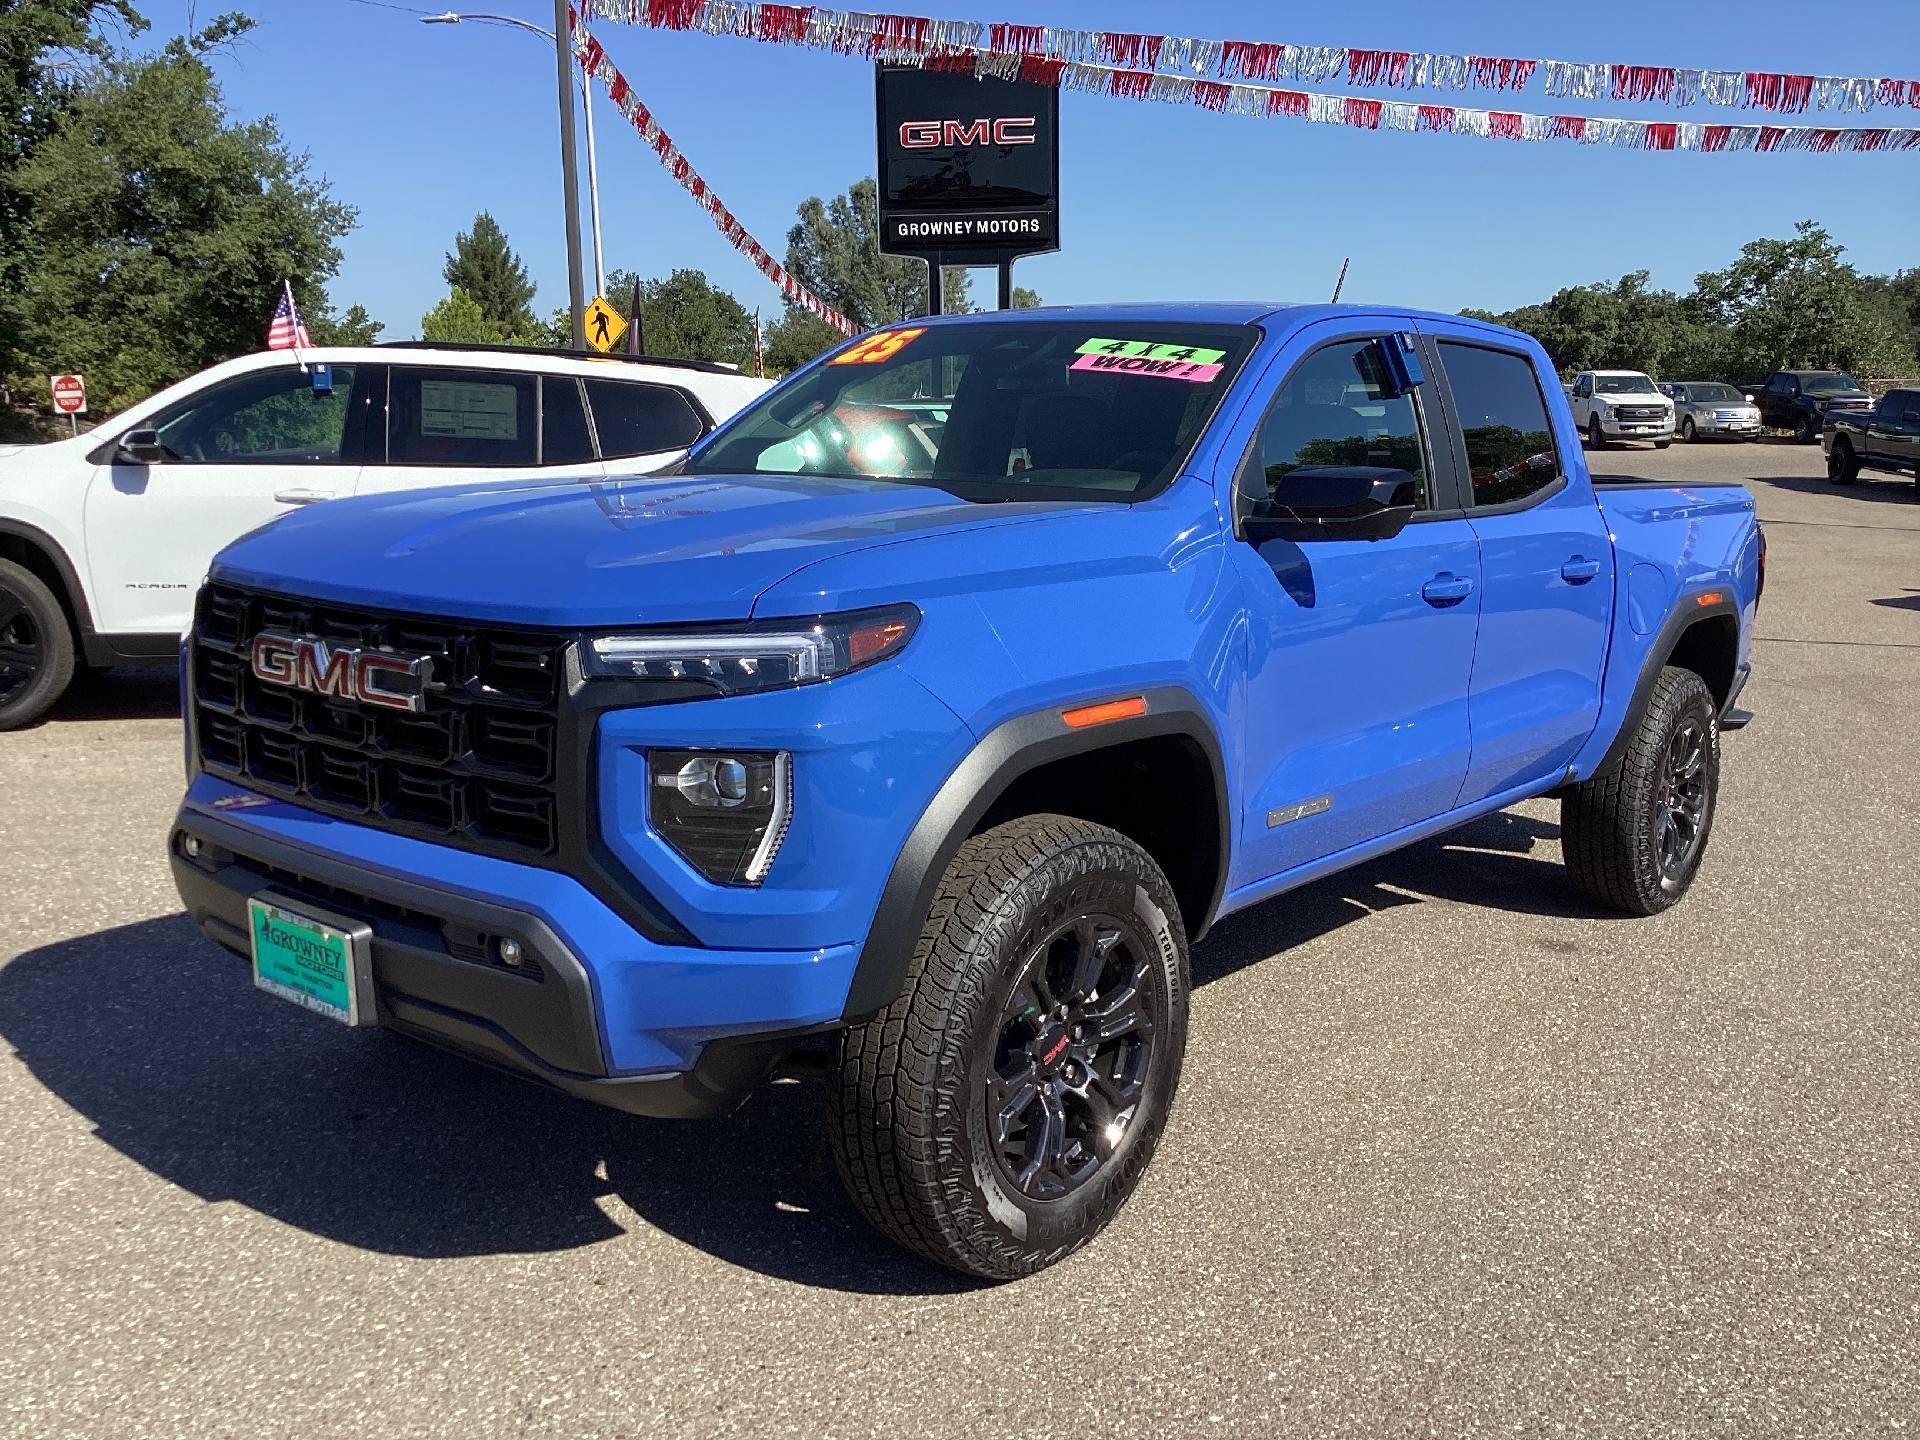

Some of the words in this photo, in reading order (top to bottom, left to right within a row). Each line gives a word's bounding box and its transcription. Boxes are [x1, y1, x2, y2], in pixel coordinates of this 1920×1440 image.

[900, 117, 1035, 148] GMC
[898, 221, 973, 236] GROWNEY
[976, 219, 1040, 233] MOTORS
[834, 328, 923, 363] 25
[57, 382, 66, 390] DO
[67, 382, 79, 390] NOT
[60, 398, 79, 406] ENTER
[252, 632, 427, 713] GMC
[270, 927, 342, 969] GROWNEY
